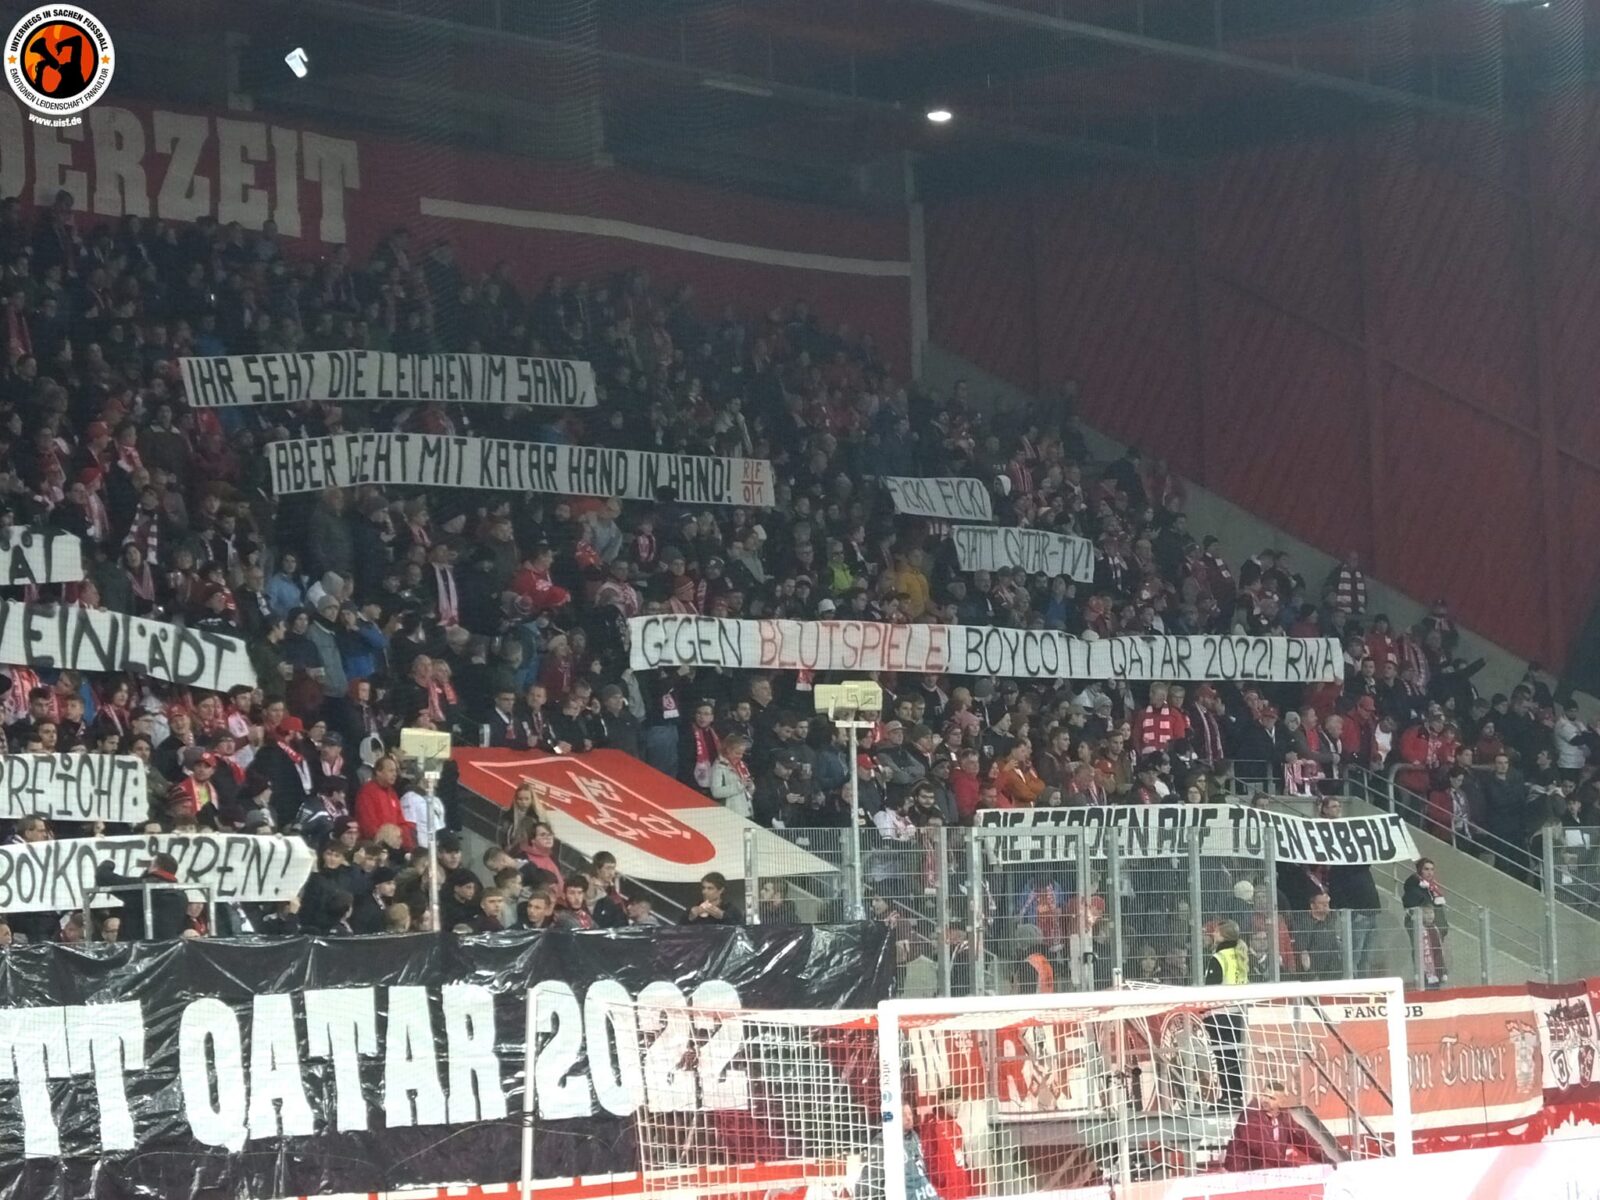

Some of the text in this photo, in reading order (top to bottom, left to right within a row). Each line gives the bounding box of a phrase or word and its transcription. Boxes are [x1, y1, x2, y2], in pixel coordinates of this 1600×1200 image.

[187, 351, 587, 405] IHR SEHT DIE LEICHEN IM SAND,
[274, 434, 731, 503] ABER GEHT MIT KATAR HAND IN HAND!
[956, 528, 999, 569] STATT
[642, 615, 742, 667] GEGEN
[965, 628, 1097, 677] BOYCOTT
[1110, 635, 1193, 680] QATAR
[1204, 636, 1274, 680] 2022!
[1344, 1005, 1424, 1019] FANCUB
[180, 984, 506, 1153] QATAR
[533, 979, 749, 1120] 2022
